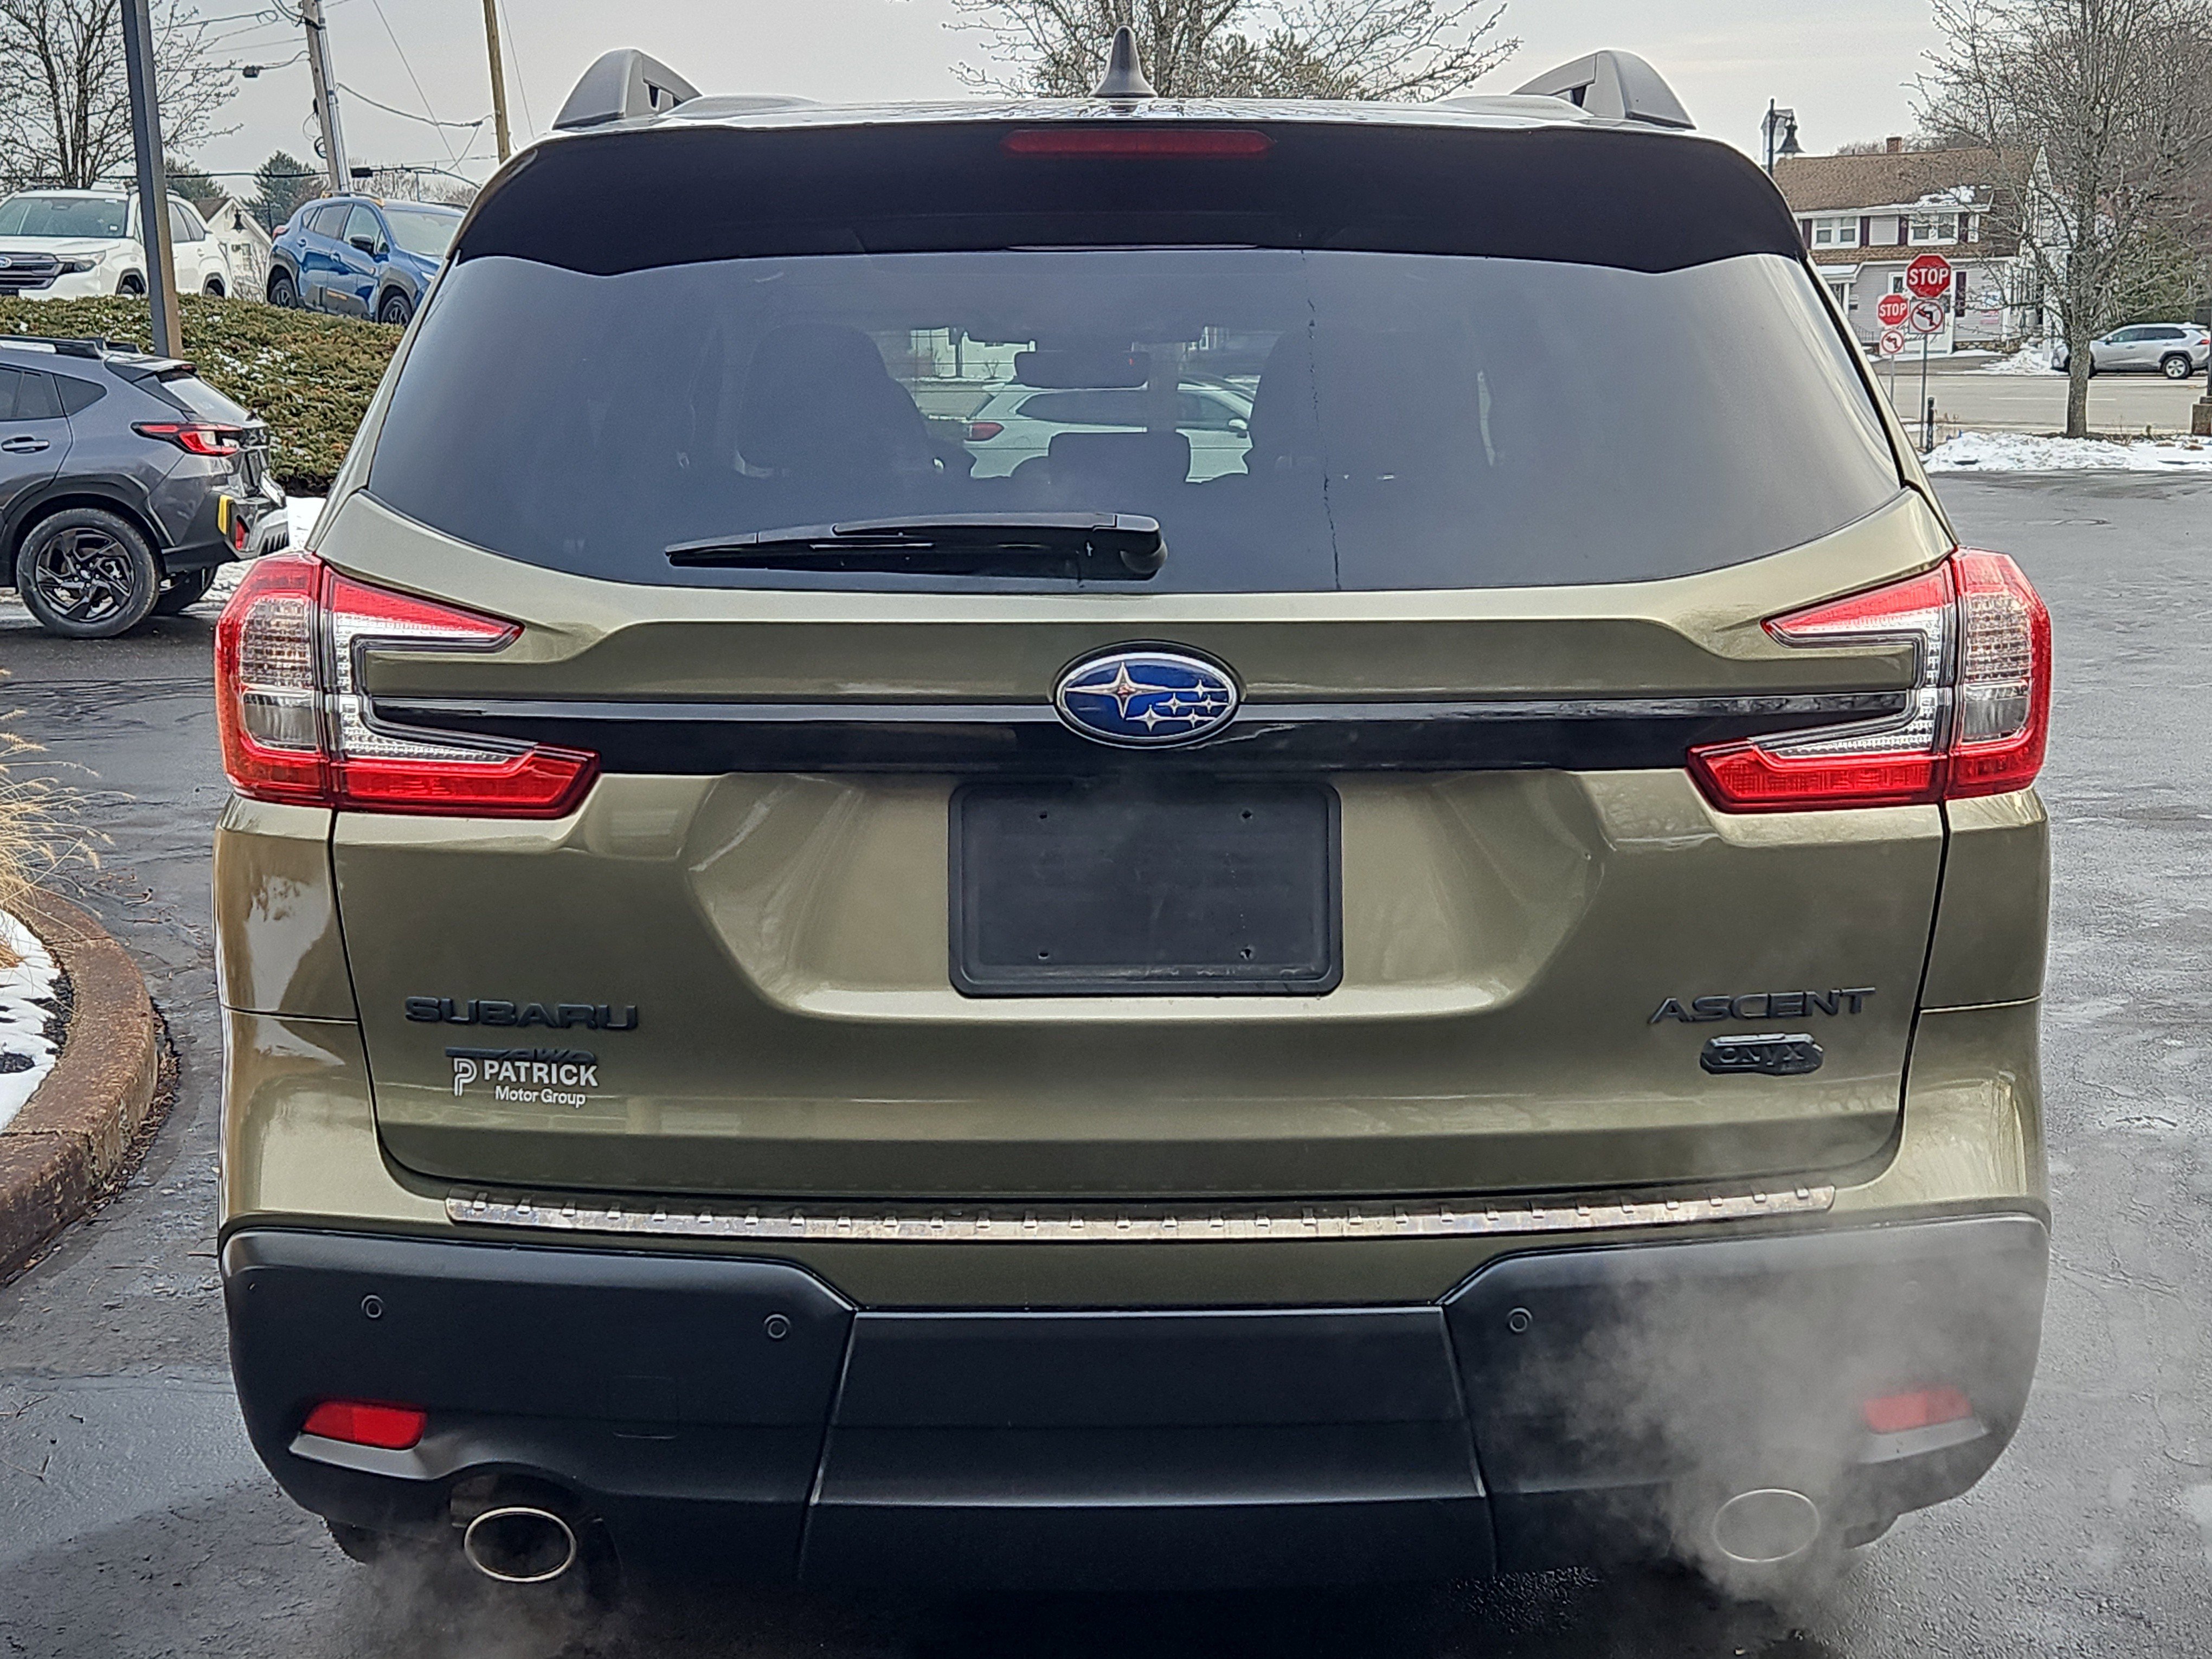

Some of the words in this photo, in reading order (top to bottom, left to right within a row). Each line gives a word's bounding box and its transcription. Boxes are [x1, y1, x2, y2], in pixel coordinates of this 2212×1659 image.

[1908, 268, 1949, 285] STOP
[1879, 303, 1907, 317] STOP
[404, 995, 638, 1030] SUBARU
[1648, 986, 1876, 1024] ASCENT
[1720, 1043, 1805, 1065] ONYX
[484, 1059, 599, 1087] PATRICK
[495, 1085, 539, 1103] Motor
[541, 1088, 586, 1109] Group
